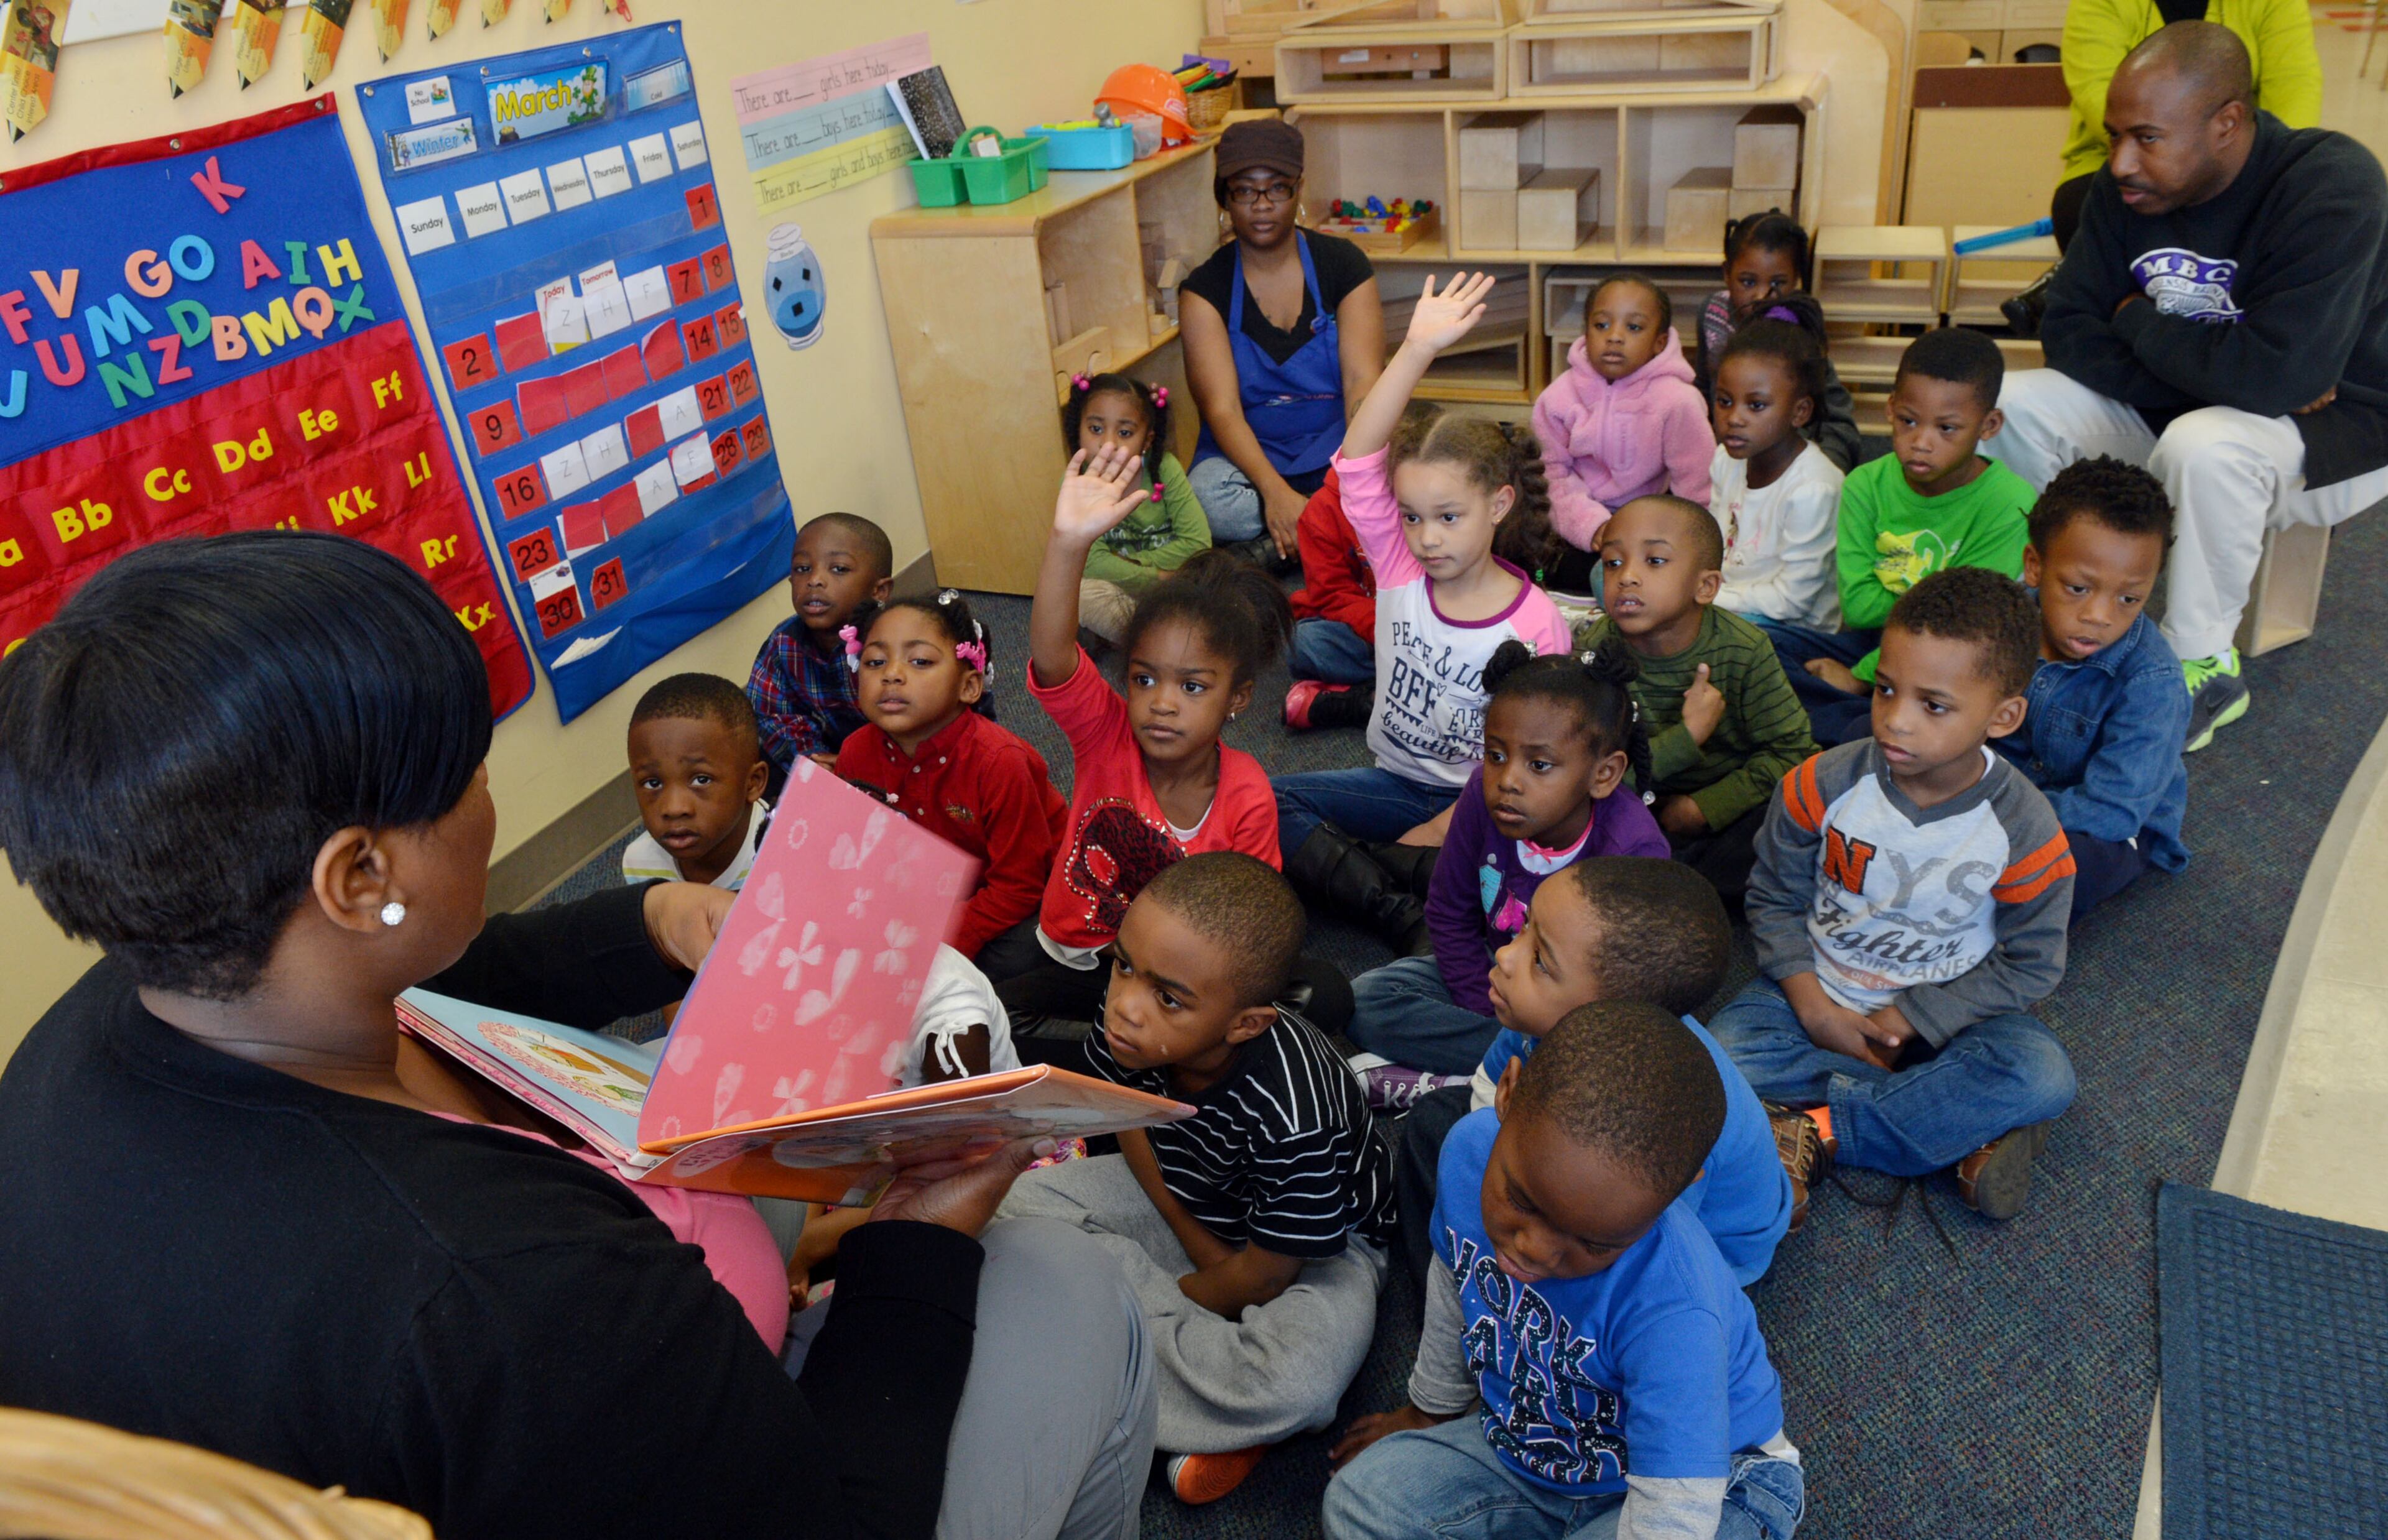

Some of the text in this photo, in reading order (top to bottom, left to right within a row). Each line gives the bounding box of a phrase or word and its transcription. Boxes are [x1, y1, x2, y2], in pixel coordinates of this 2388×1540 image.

[7, 88, 18, 114] Center
[16, 98, 26, 119] Child
[411, 96, 430, 106] School
[496, 79, 572, 122] March
[650, 91, 662, 100] Cold
[735, 88, 769, 114] There
[773, 90, 792, 104] are
[820, 63, 842, 101] girls
[844, 64, 862, 86] here
[412, 135, 459, 157] Winter
[745, 132, 781, 159] There
[784, 134, 801, 149] are
[820, 115, 843, 145] boys
[843, 112, 862, 134] here
[190, 156, 246, 214] K
[410, 138, 703, 234] Sunday Monday Tuesday Wednesday Thursday Friday Saturday
[755, 178, 785, 205] There
[786, 179, 802, 196] are
[829, 155, 849, 189] girls
[850, 154, 866, 174] and
[697, 196, 708, 219] 1
[0, 290, 32, 344] F
[29, 269, 79, 318] V
[241, 239, 281, 289] A
[285, 241, 311, 285] I
[317, 238, 363, 287] H
[543, 284, 565, 299] Today
[581, 267, 614, 286] Tomorrow
[678, 255, 723, 293] 7 8
[33, 333, 86, 387] U
[85, 293, 154, 358] M
[165, 300, 211, 348] D
[688, 310, 739, 352] 14 15
[97, 333, 193, 409] N Z
[460, 348, 482, 376] 2
[703, 369, 752, 411] 21 22
[486, 414, 503, 441] 9
[716, 426, 764, 467] 28 29
[51, 498, 113, 543] Bb
[144, 467, 192, 502] Cc
[212, 428, 274, 474] Dd
[298, 408, 339, 442] Ee
[371, 371, 404, 409] Ff
[327, 486, 377, 526] Kk
[404, 451, 432, 489] Ll
[503, 476, 534, 507] 16
[420, 535, 458, 569] Rr
[517, 538, 549, 571] 23
[544, 566, 621, 628] 30 31
[1434, 645, 1451, 680] &
[1453, 663, 1483, 693] LO
[1420, 725, 1436, 737] LIFE
[1816, 897, 1965, 963] Fighter
